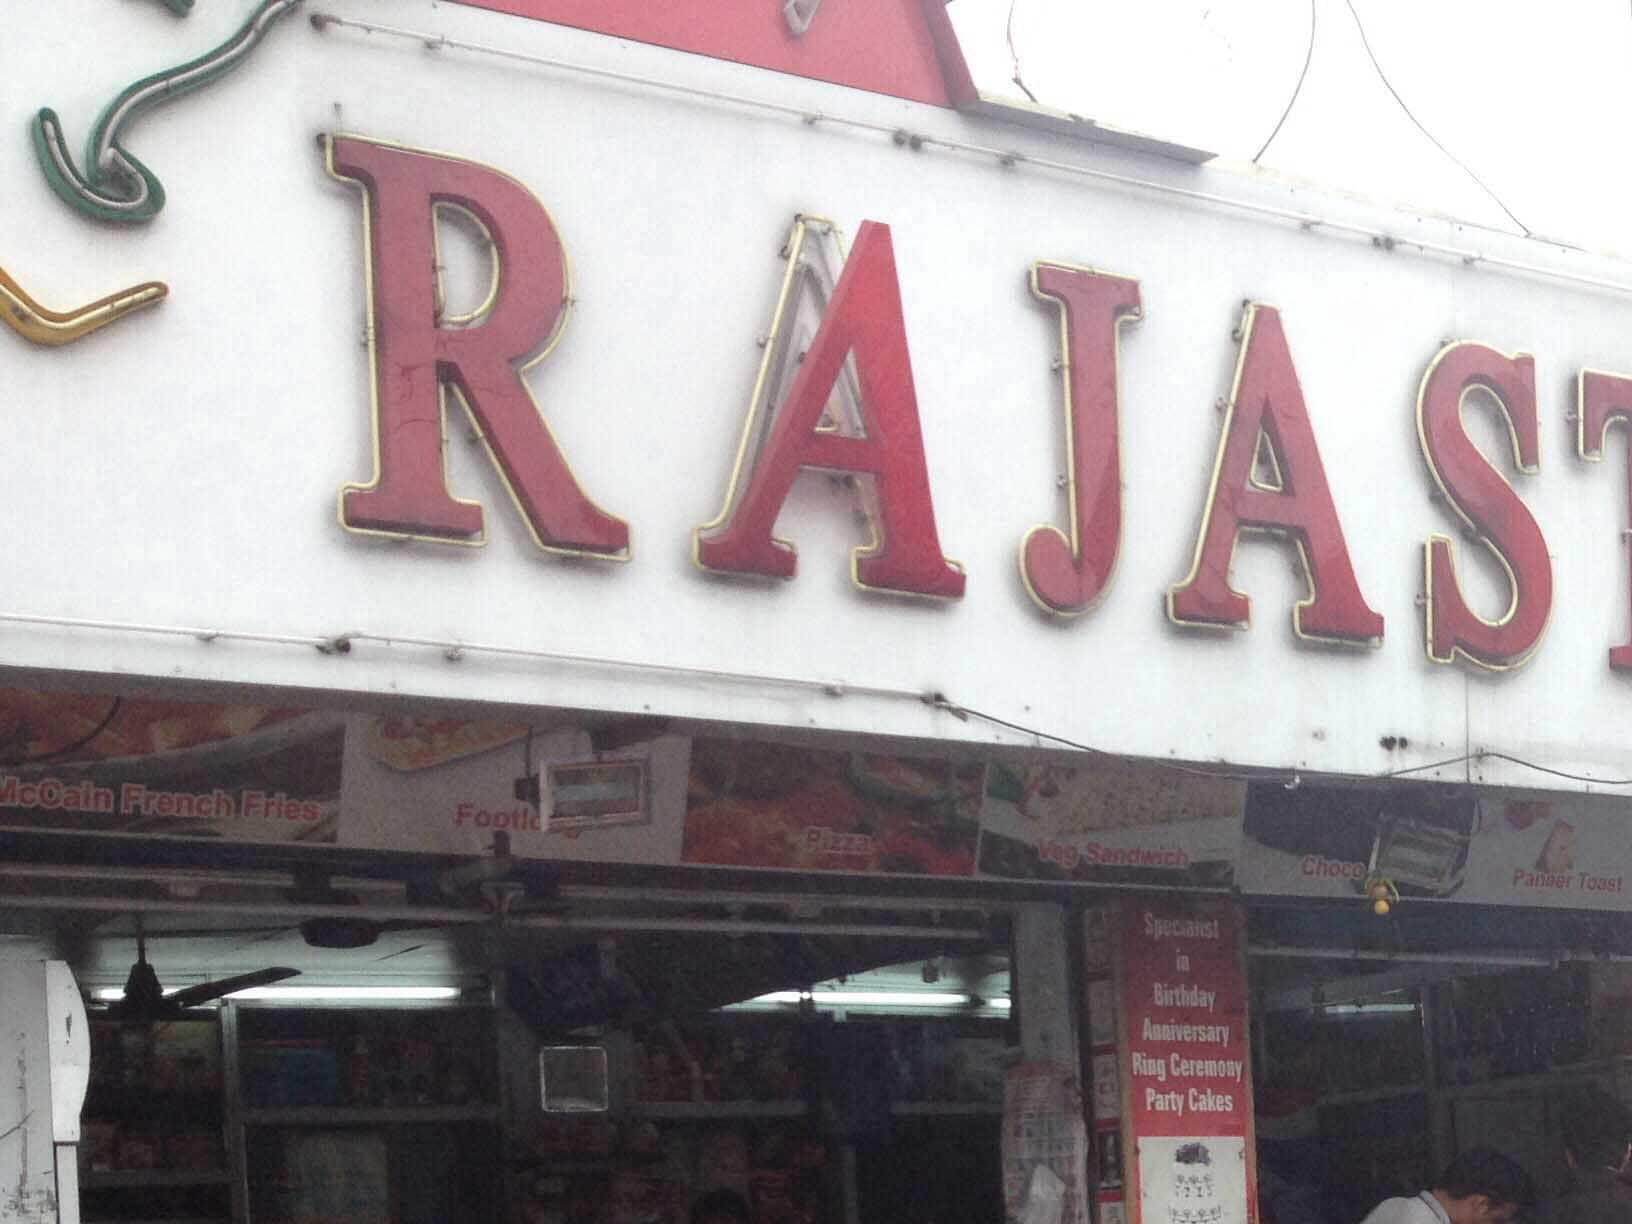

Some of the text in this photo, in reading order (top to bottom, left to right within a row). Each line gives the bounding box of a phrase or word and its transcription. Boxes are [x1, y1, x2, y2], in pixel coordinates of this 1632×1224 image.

[0, 775, 322, 823] McCain French Fries
[1036, 840, 1191, 869] Veg Sandwich
[1512, 867, 1624, 893] Paneer Toast
[1176, 949, 1191, 972] in
[1153, 983, 1216, 1013] Birthday
[1143, 1018, 1230, 1048] Anniversary
[1132, 1052, 1243, 1082] Ring Ceremony
[1146, 1088, 1233, 1116] Party Cakes
